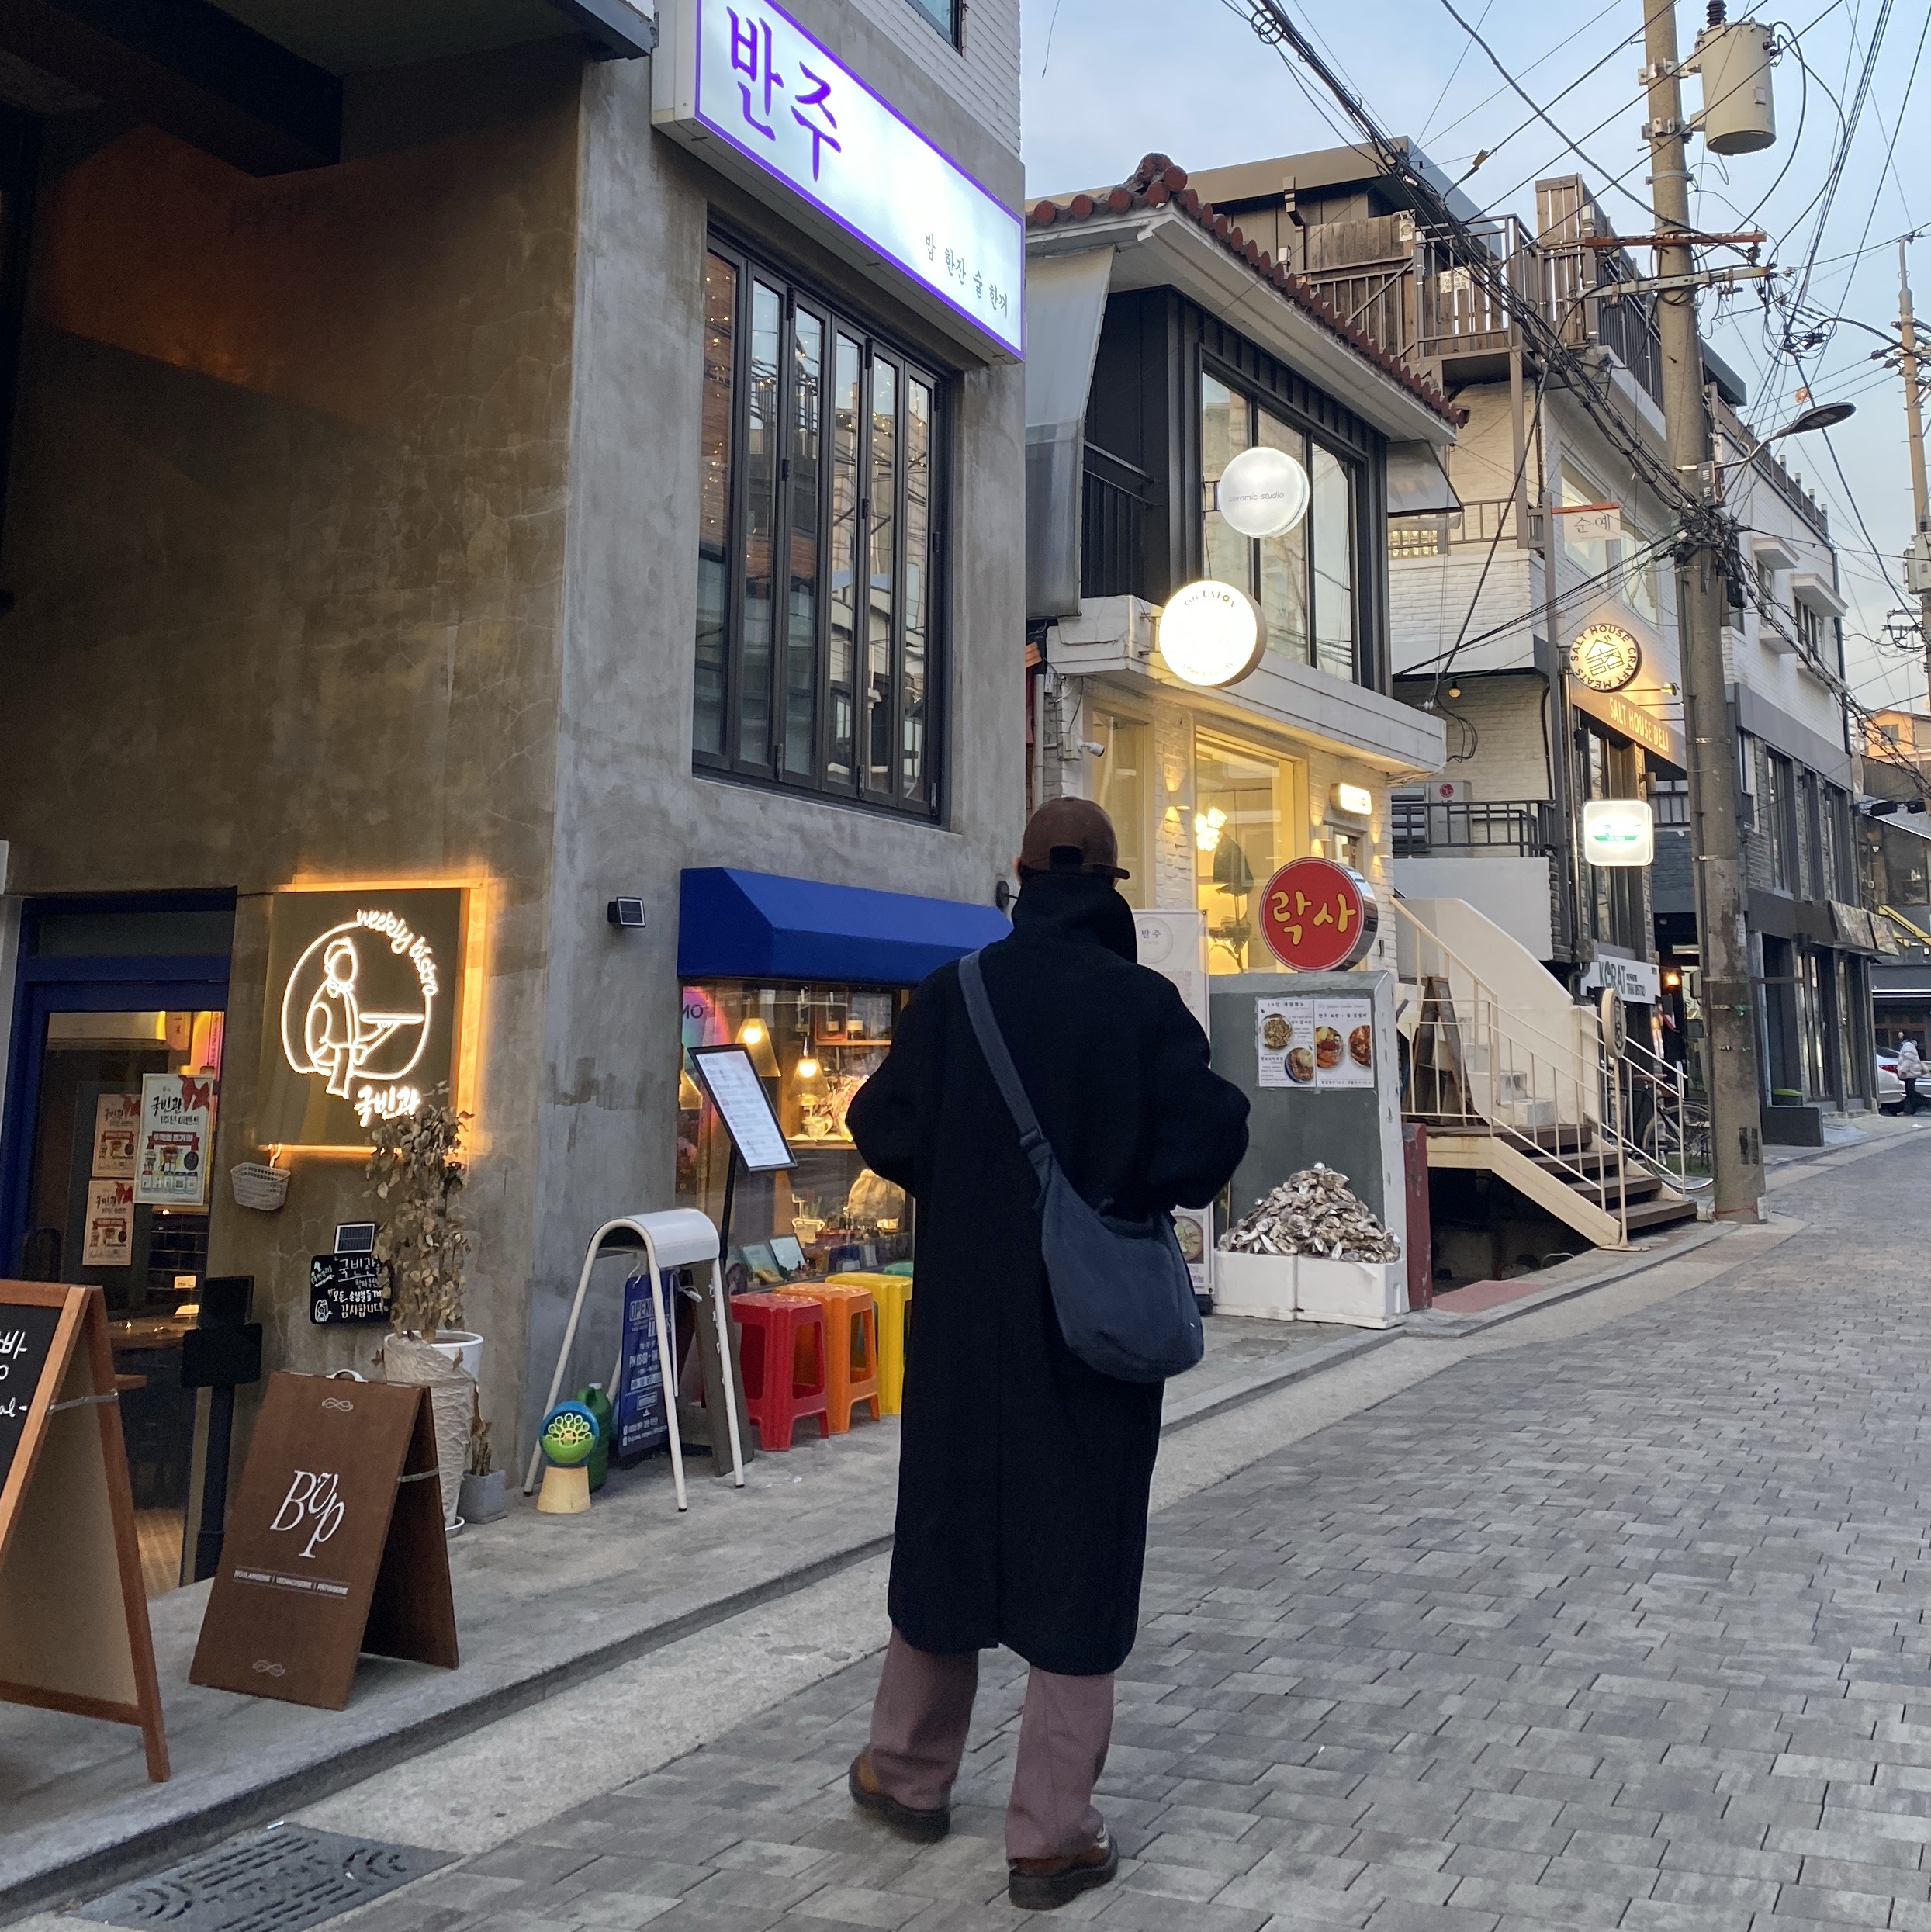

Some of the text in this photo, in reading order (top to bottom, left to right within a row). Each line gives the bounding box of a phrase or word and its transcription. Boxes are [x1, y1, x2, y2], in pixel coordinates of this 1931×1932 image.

[726, 6, 842, 181] 반주
[924, 233, 1008, 318] 밥 한잔 술 한끼
[1228, 490, 1284, 502] ceramic studio
[1571, 625, 1637, 689] SALT HOUSE CRAFT MEATS
[1609, 696, 1669, 752] SALT HOUSE DELI
[1271, 890, 1357, 946] 락사
[356, 909, 438, 996] weekly bistro
[151, 1096, 182, 1116] 국빈관
[178, 1115, 199, 1125] 이벤트
[354, 1085, 421, 1127] 국빈관
